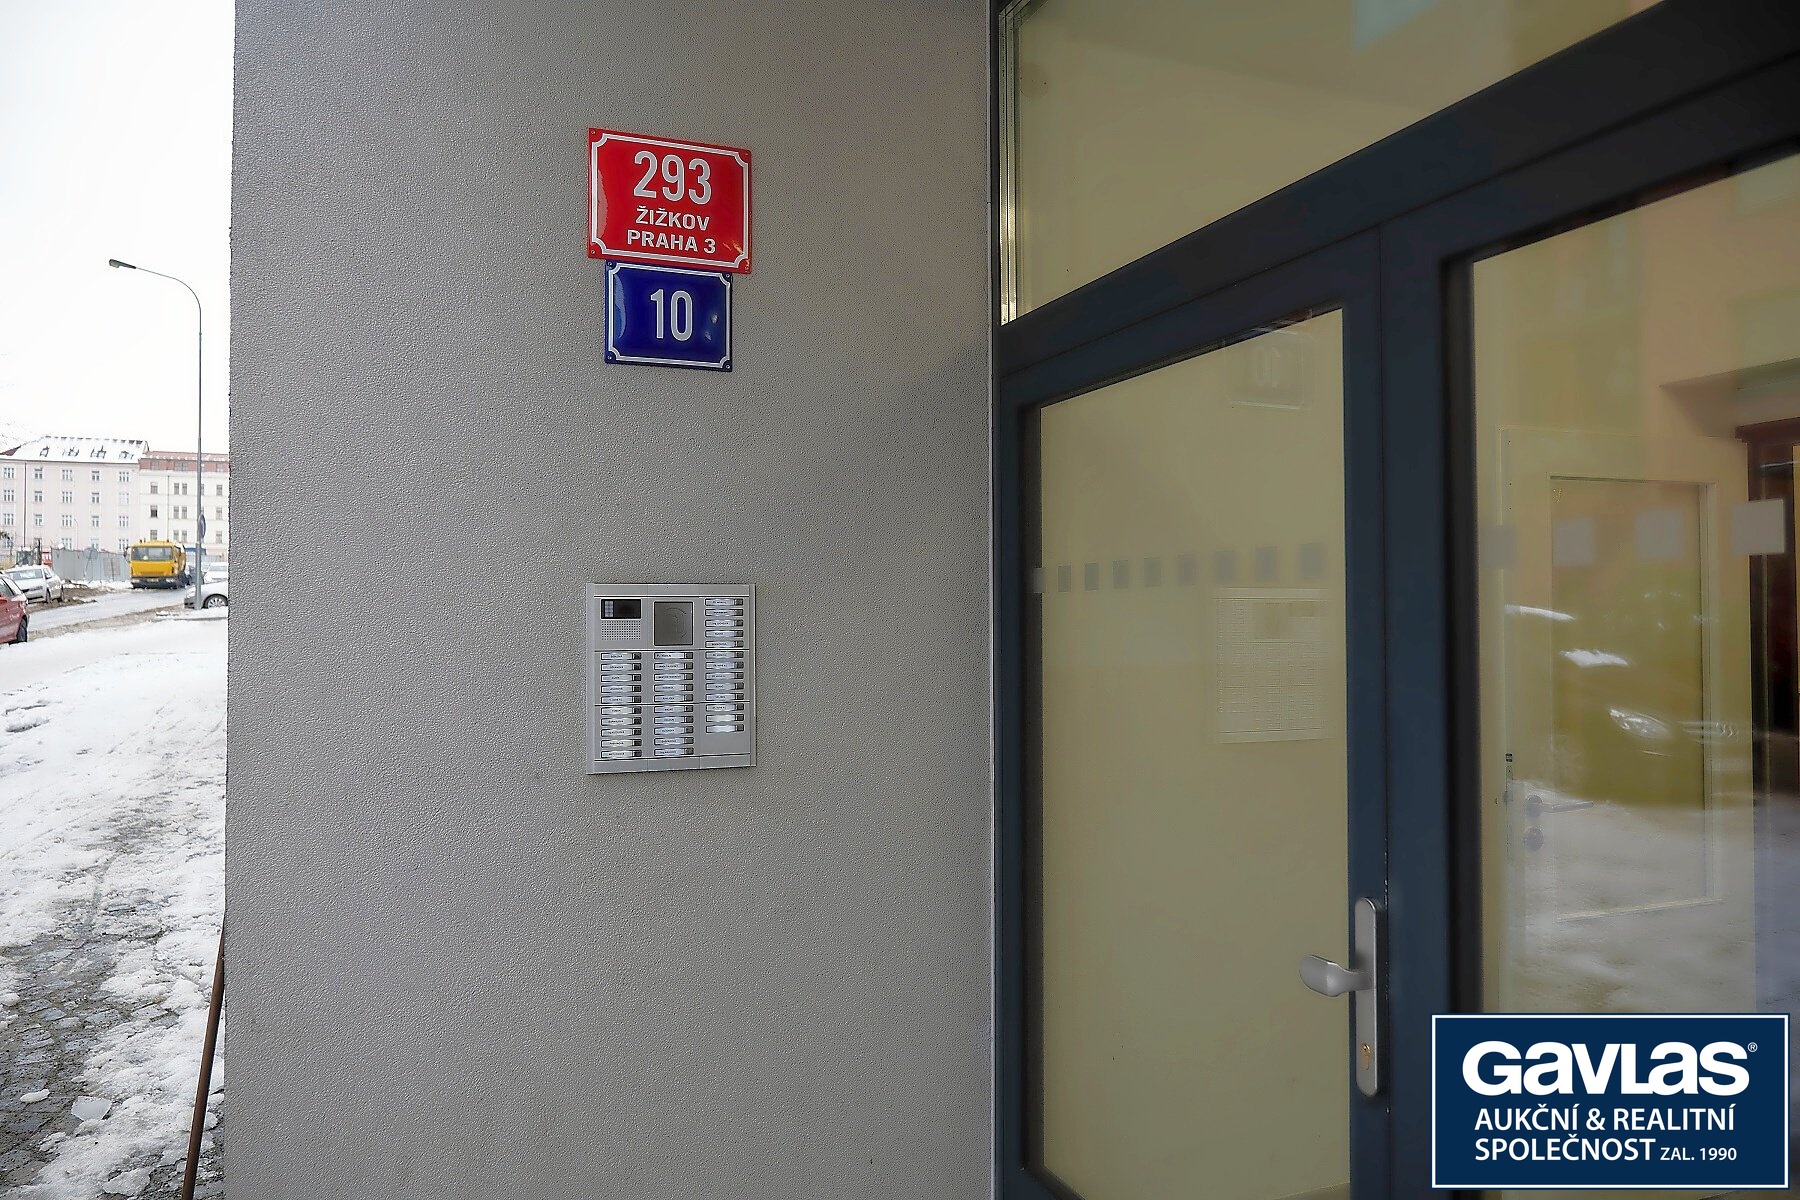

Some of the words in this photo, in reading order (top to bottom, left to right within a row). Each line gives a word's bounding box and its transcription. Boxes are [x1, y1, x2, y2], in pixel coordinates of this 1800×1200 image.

[633, 150, 712, 205] 293
[635, 205, 710, 231] ŽIŽKOV
[627, 229, 698, 252] PRAHA
[703, 238, 716, 254] 3
[650, 288, 693, 341] 10
